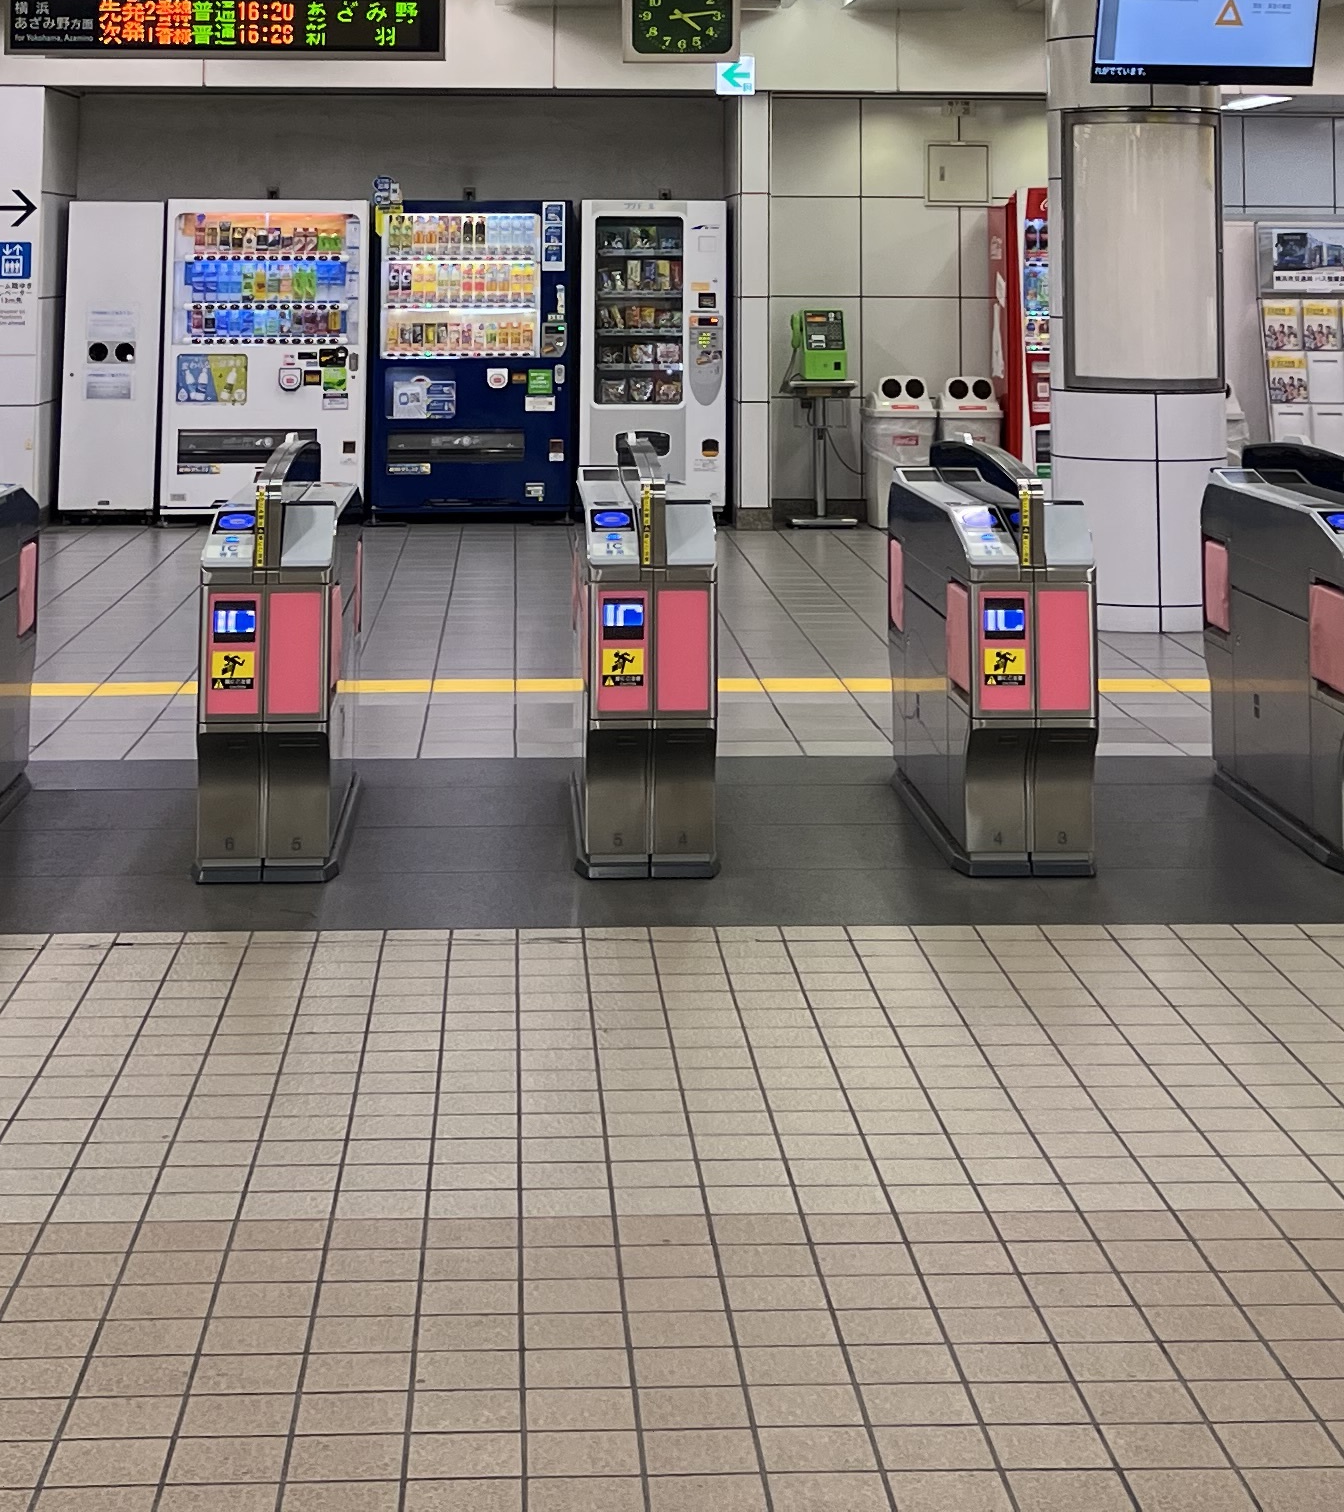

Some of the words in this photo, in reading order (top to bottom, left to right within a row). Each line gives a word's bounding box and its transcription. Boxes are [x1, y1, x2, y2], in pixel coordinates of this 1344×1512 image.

[642, 11, 652, 21] 9
[712, 11, 722, 21] 3
[15, 17, 94, 30] あざみ野方面
[649, 27, 658, 37] 8
[706, 27, 714, 36] 4
[663, 37, 672, 47] 7
[677, 40, 687, 50] 6
[692, 37, 701, 47] 5
[225, 837, 235, 851] 6
[291, 837, 302, 851] 5
